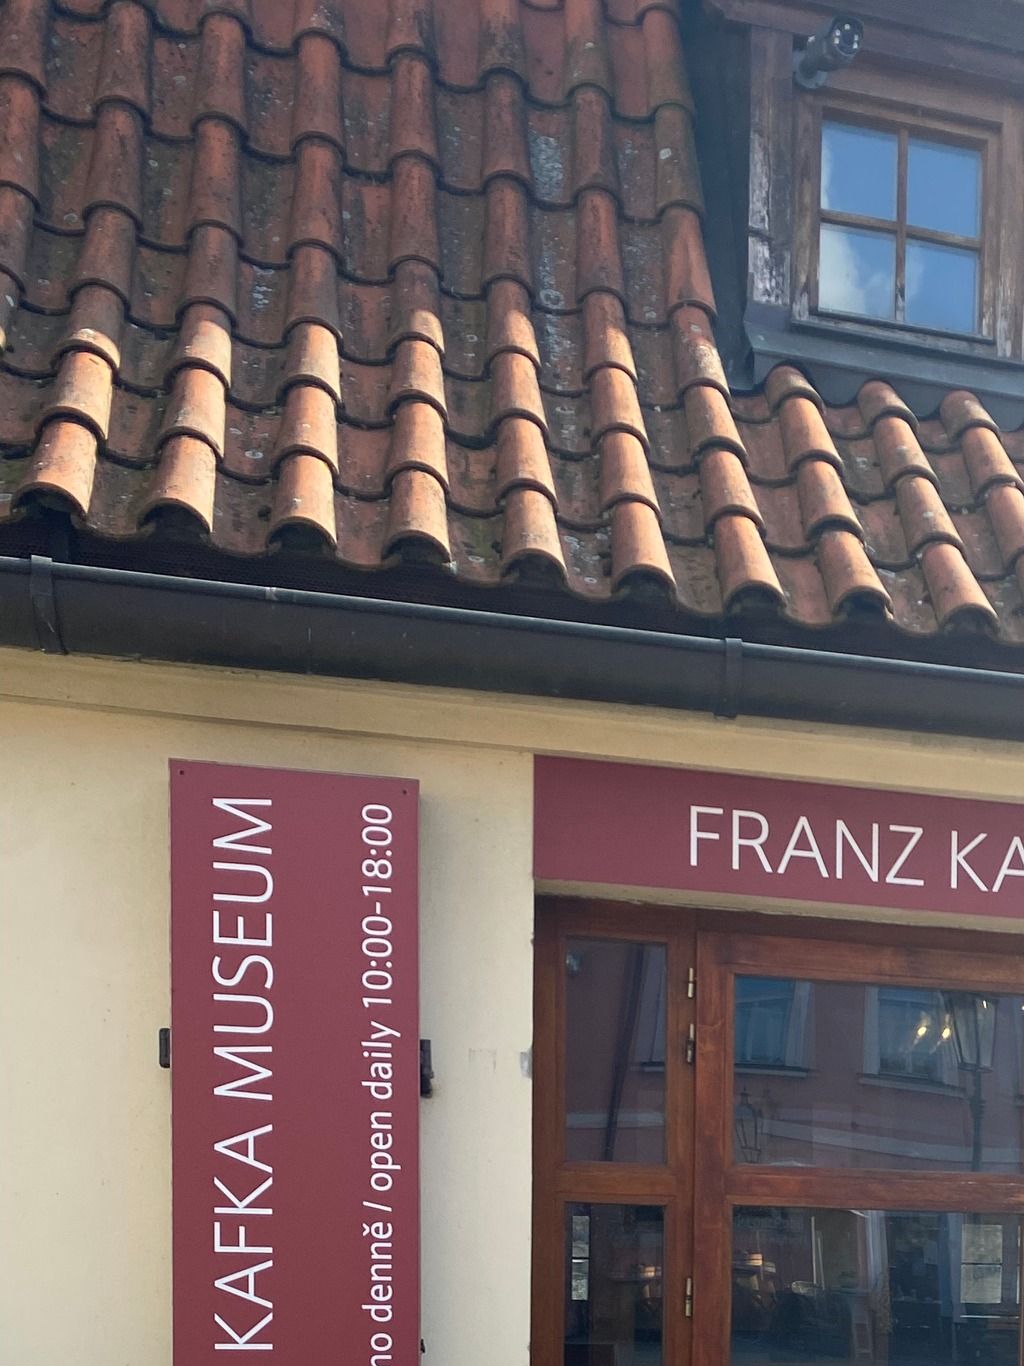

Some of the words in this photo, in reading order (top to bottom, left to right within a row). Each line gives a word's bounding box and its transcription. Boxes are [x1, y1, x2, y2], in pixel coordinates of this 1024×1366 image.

[687, 804, 926, 887] FRANZ
[211, 797, 275, 1102] MUSEUM
[361, 803, 394, 1008] 10:00-18:00
[361, 1020, 401, 1101] daily
[369, 1111, 402, 1192] open
[212, 1123, 274, 1351] KAFKA
[362, 1200, 393, 1213] /
[361, 1222, 394, 1323] denně
